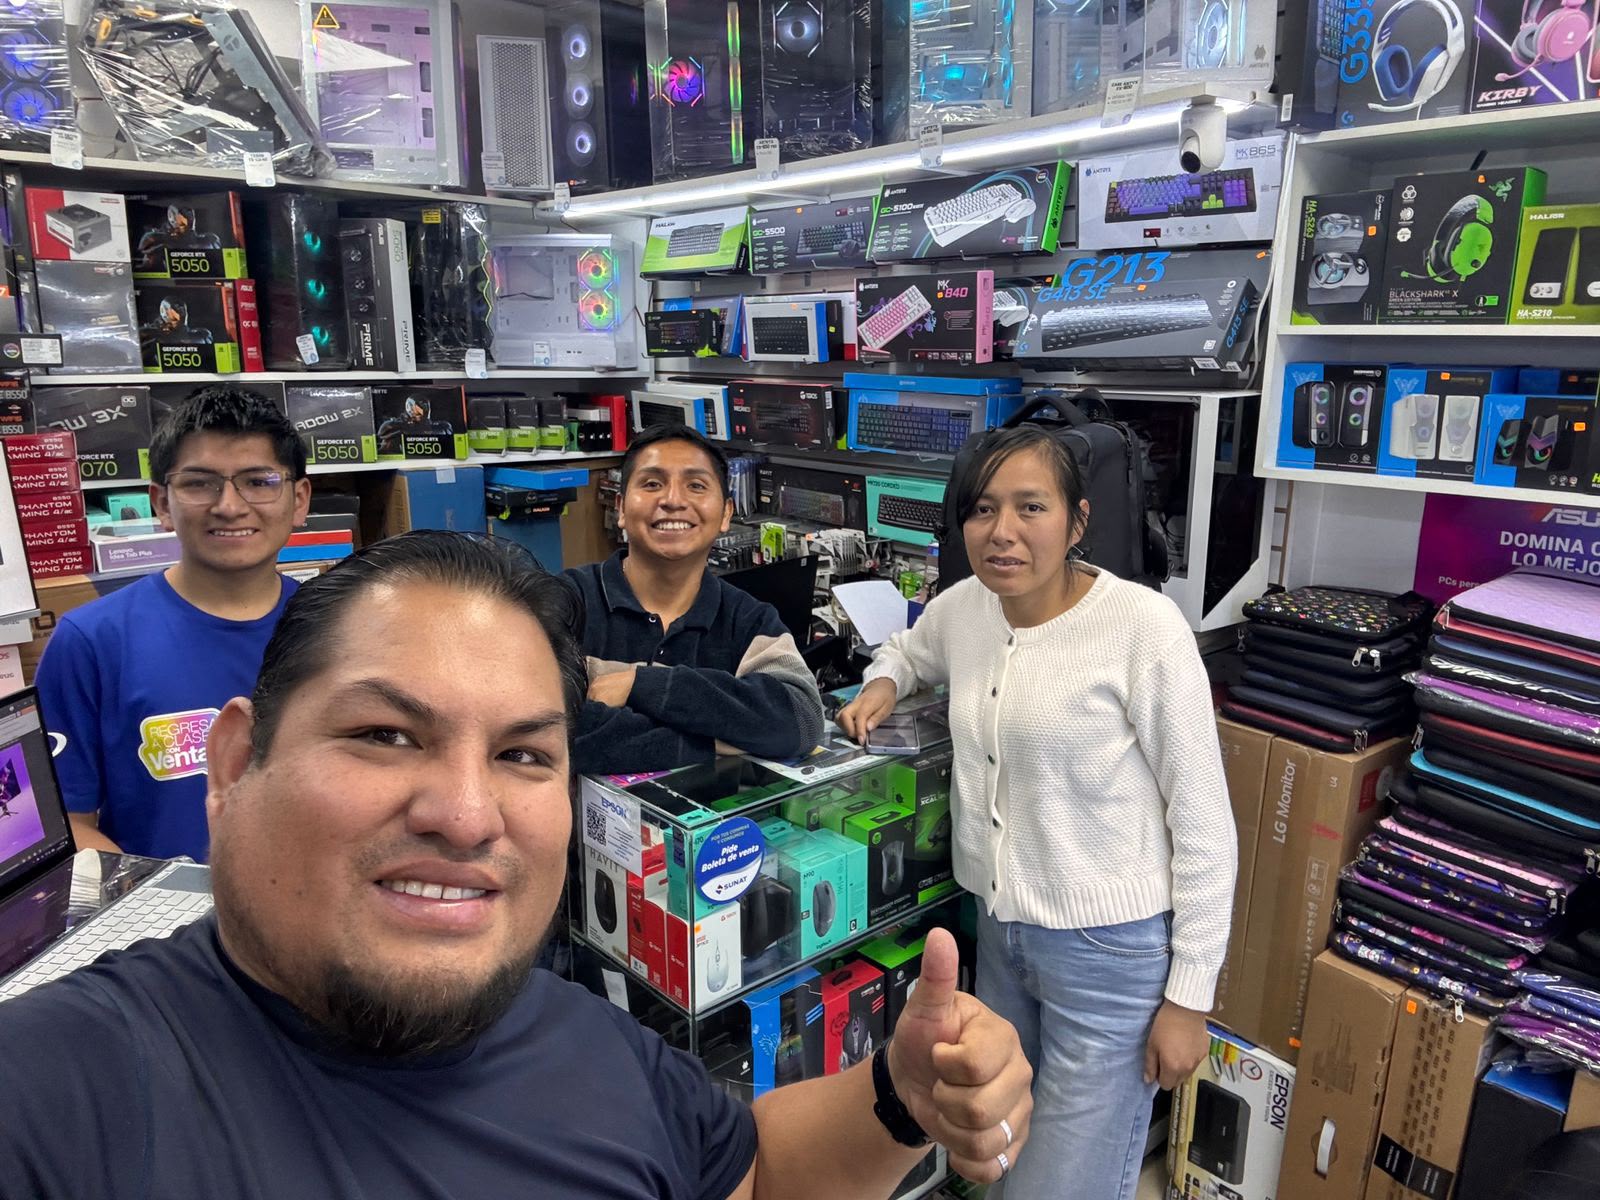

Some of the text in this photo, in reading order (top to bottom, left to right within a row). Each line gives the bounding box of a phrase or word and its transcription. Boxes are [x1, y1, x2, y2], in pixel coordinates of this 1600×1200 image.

[1478, 84, 1543, 103] KIRBY
[1306, 200, 1318, 239] HA-S263
[171, 259, 210, 273] 5050
[1062, 251, 1171, 288] G213
[945, 287, 968, 298] 840
[1389, 290, 1445, 299] BLACKSHARK
[1516, 308, 1553, 318] HA-S210
[362, 323, 374, 367] PRIME
[163, 353, 202, 367] 5050
[5, 389, 28, 400] B550
[2, 424, 24, 434] B550
[7, 443, 64, 453] PHANTOM
[317, 446, 359, 460] 5050
[406, 443, 442, 455] 5050
[12, 472, 68, 482] PHANTOM
[1500, 531, 1585, 555] DOMINA
[1512, 551, 1538, 567] LO
[1438, 575, 1457, 586] PCs
[1273, 757, 1297, 844] LG Monitor
[601, 797, 629, 819] EPSON
[721, 844, 739, 857] Pide
[590, 847, 619, 873] HAVIT
[701, 845, 760, 873] Boleta de venta
[723, 875, 748, 891] SUNAT
[1270, 1073, 1290, 1131] EPSON
